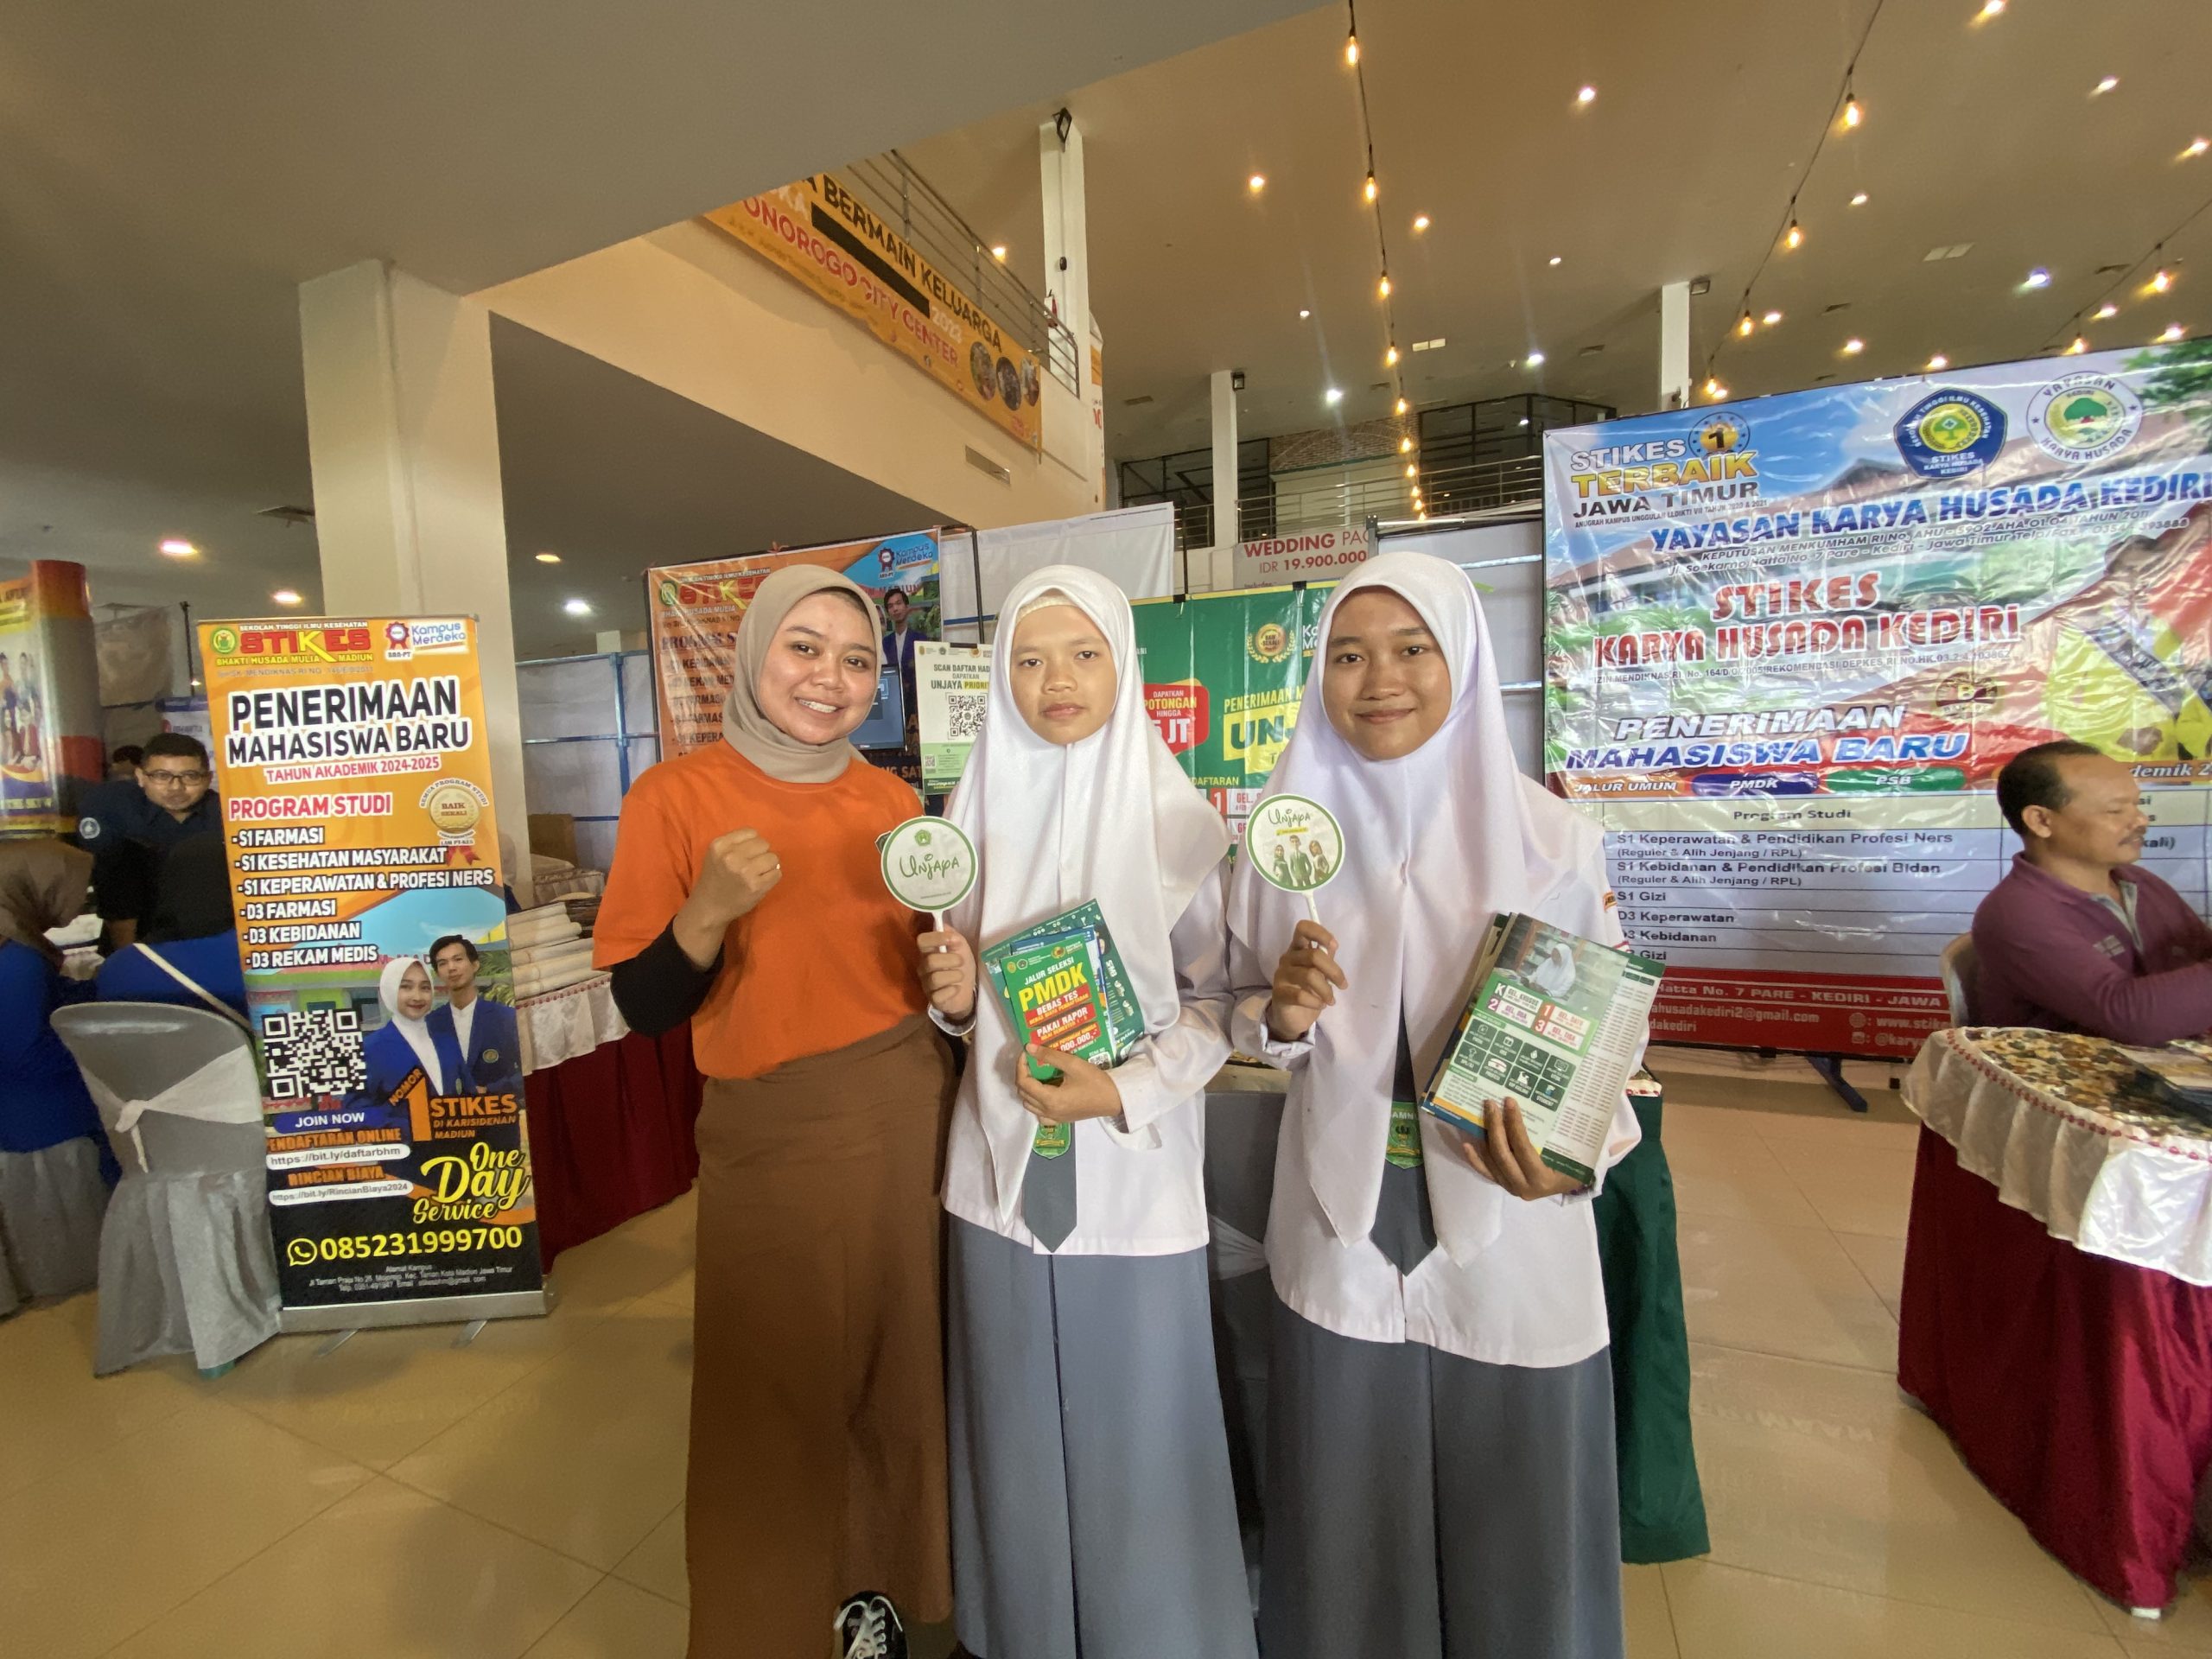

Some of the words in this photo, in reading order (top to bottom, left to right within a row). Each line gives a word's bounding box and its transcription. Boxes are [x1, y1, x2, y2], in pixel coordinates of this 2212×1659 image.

[823, 174, 917, 278] BERMAIN
[920, 262, 1003, 353] KELUARGA
[902, 309, 959, 367] CENTER
[1708, 428, 1726, 449] 1
[1571, 438, 1686, 472] STIKES
[1931, 451, 1975, 462] STIKES
[1571, 450, 1758, 499] TERBAIK
[1573, 496, 1650, 518] JAWA
[1662, 481, 1759, 508] TIMUR
[1605, 516, 1630, 525] KAMPUS
[1650, 512, 1800, 552] YAYASAN
[1811, 499, 1928, 535] KARYA
[1939, 481, 2089, 522] HUSADA
[1244, 533, 1336, 558] WEDDING
[1702, 545, 1777, 561] KEPUTUSAN
[1778, 537, 1867, 553] MENKUMHAM
[1826, 547, 1859, 560] Pare
[1259, 562, 1278, 574] IDR
[1284, 550, 1367, 570] 19.900.000
[1711, 572, 1879, 621] STIKES
[411, 623, 461, 639] Kampus
[412, 632, 467, 645] Merdeka
[1593, 631, 1707, 669] KARYA
[1715, 616, 1867, 663] HUSADA
[1878, 603, 2021, 649] KEDIRI
[240, 628, 372, 662] STIKES
[216, 657, 249, 666] BHAKTI
[251, 656, 289, 665] HUSADA
[290, 655, 321, 664] MULIA
[338, 654, 373, 663] MADIUN
[933, 664, 950, 672] SCAN
[952, 664, 976, 672] DAFTAR
[931, 680, 963, 690] UNJAYA
[1153, 690, 1185, 699] DAPATKAN
[231, 679, 457, 732] PENERIMAAN
[1224, 686, 1293, 713] PENERIMAAN
[1167, 718, 1191, 744] JT
[1613, 704, 1907, 741] PENERIMAAN
[228, 727, 391, 765] MAHASISWA
[396, 721, 467, 752] BARU
[1566, 738, 1821, 769] MAHASISWA
[1834, 733, 1970, 764] BARU
[266, 768, 311, 782] TAHUN
[315, 761, 378, 779] AKADEMIK
[381, 756, 440, 773] 2024-2025
[1874, 774, 1912, 786] PSB
[435, 779, 471, 789] PROGRAM
[1627, 780, 1677, 793] UMUM
[1729, 779, 1778, 791] PMDK
[230, 797, 328, 819] PROGRAM
[334, 793, 391, 815] STUDI
[1808, 809, 1851, 819] Studi
[255, 827, 324, 846] FARMASI
[1618, 835, 1633, 844] S1
[1640, 834, 1736, 847] Keperawatan
[1741, 834, 1751, 844] &
[1757, 833, 1845, 844] Pendidikan
[1851, 833, 1909, 844] Profesi
[1914, 832, 1953, 843] Ners
[257, 851, 349, 870] KESEHATAN
[352, 847, 447, 866] MASYARAKAT
[1681, 849, 1707, 857] Alih
[1710, 849, 1759, 859] Jenjang
[1771, 849, 1802, 859] RPL)
[1618, 861, 1633, 871] S1
[1639, 861, 1717, 872] Kebidanan
[1722, 862, 1732, 872] &
[1738, 862, 1825, 873] Pendidikan
[1830, 862, 1888, 874] Profesi
[1892, 862, 1942, 874] Bidan
[260, 874, 374, 895] KEPERAWATAN
[377, 874, 388, 889] &
[390, 871, 449, 889] PROFESI
[452, 869, 494, 887] NERS
[1681, 875, 1707, 885] Alih
[1710, 876, 1759, 887] Jenjang
[1770, 876, 1802, 887] RPL)
[1618, 892, 1634, 901] S1
[1639, 891, 1666, 901] Gizi
[266, 899, 336, 919] FARMASI
[1618, 911, 1636, 921] D3
[1641, 911, 1734, 925] Keperawatan
[269, 923, 360, 944] KEBIDANAN
[1641, 931, 1717, 943] Kebidanan
[272, 948, 328, 968] REKAM
[331, 945, 378, 963] MEDIS
[1640, 950, 1667, 961] Gizi
[1025, 969, 1046, 985] JALUR
[1046, 956, 1075, 975] SELEKSI
[1019, 962, 1088, 1012] PMDK
[1495, 982, 1506, 996] K
[1703, 986, 1728, 996] No.
[1751, 988, 1794, 1000] PARE
[1811, 991, 1871, 1004] KEDIRI
[1888, 995, 1941, 1007] JAWA
[1037, 998, 1062, 1015] BEBAS
[1063, 990, 1078, 1003] TES
[1488, 998, 1499, 1011] 2
[1037, 1020, 1061, 1037] PAKAI
[1062, 1007, 1088, 1025] RAPOR
[388, 1068, 423, 1107] NOMOR
[295, 1113, 328, 1128] JOIN
[332, 1112, 365, 1124] NOW
[405, 1076, 432, 1142] 1
[429, 1094, 518, 1118] STIKES
[446, 1116, 517, 1128] KARISIDENAN
[267, 1131, 354, 1152] ENDAFTARAN
[357, 1128, 402, 1145] ONLINE
[435, 1129, 475, 1139] MADIUN
[270, 1147, 400, 1166] https://bit.ly/daftarbhm
[469, 1141, 524, 1172] One
[346, 1166, 385, 1181] BIAYA
[421, 1156, 531, 1210] Day
[413, 1198, 499, 1224] Service
[321, 1226, 523, 1261] 085231999700
